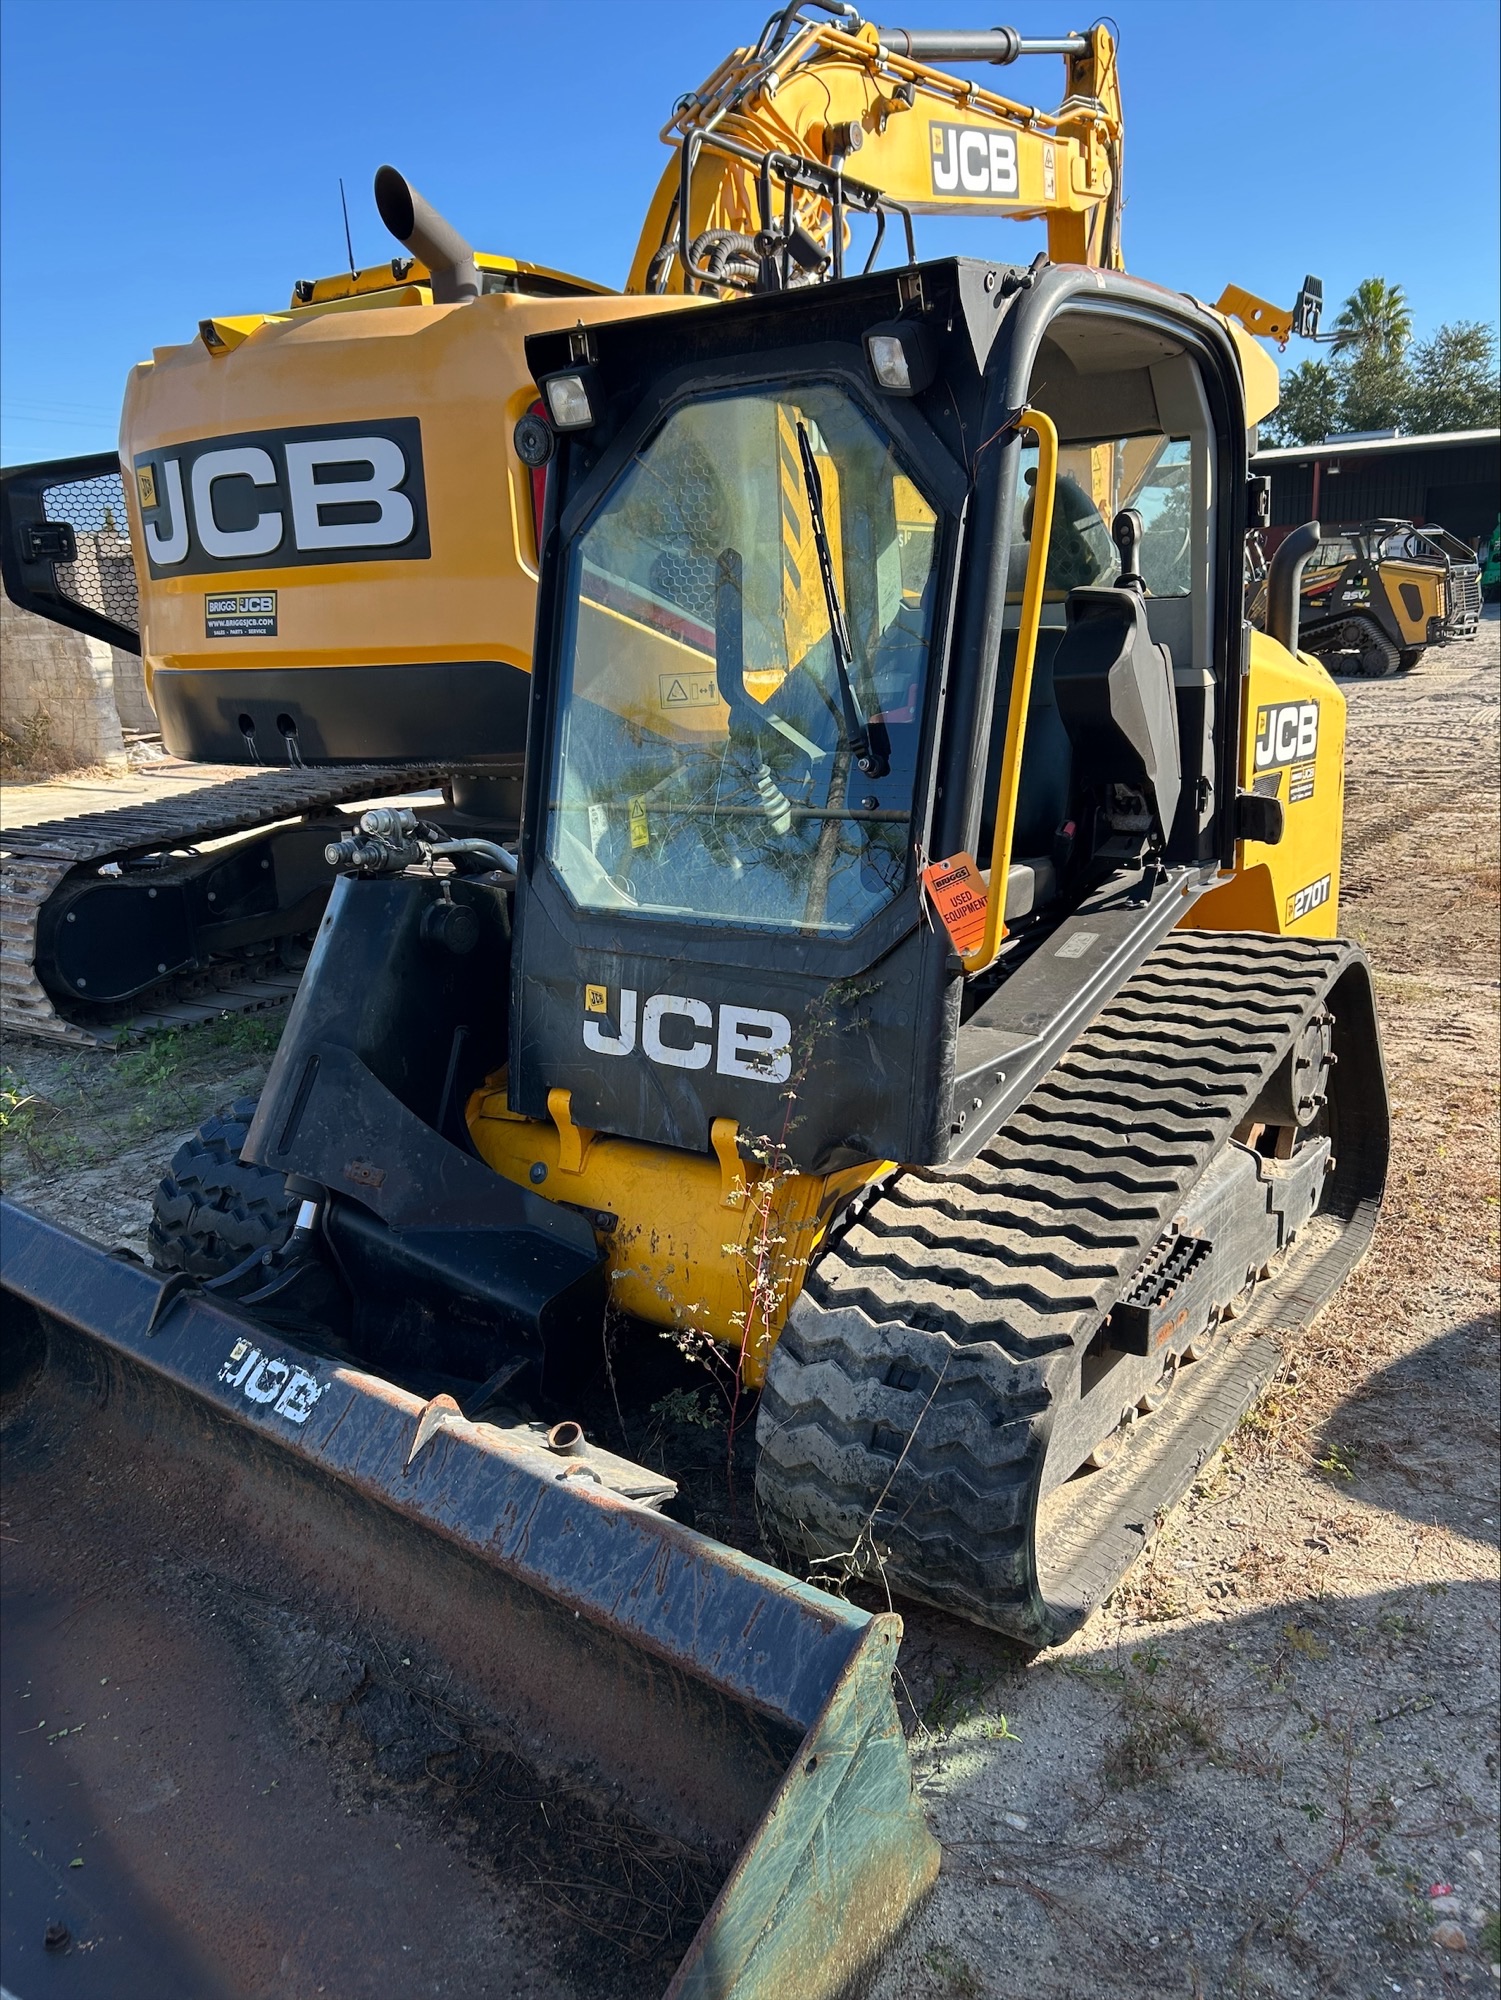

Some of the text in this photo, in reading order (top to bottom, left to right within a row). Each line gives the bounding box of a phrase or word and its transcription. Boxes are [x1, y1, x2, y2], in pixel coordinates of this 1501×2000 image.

[933, 129, 1018, 193] JCB
[145, 437, 414, 566] JCB
[208, 619, 273, 627] WWW.BRIGGSJCB.COM
[209, 598, 273, 612] BRIGGS JCB
[1256, 704, 1318, 766] JCB
[936, 869, 967, 888] BRIGGS
[950, 891, 972, 907] USED
[1293, 875, 1330, 919] 270T
[943, 896, 988, 924] EQUIPMENT
[583, 988, 792, 1084] JCB
[218, 1347, 325, 1424] JCB
